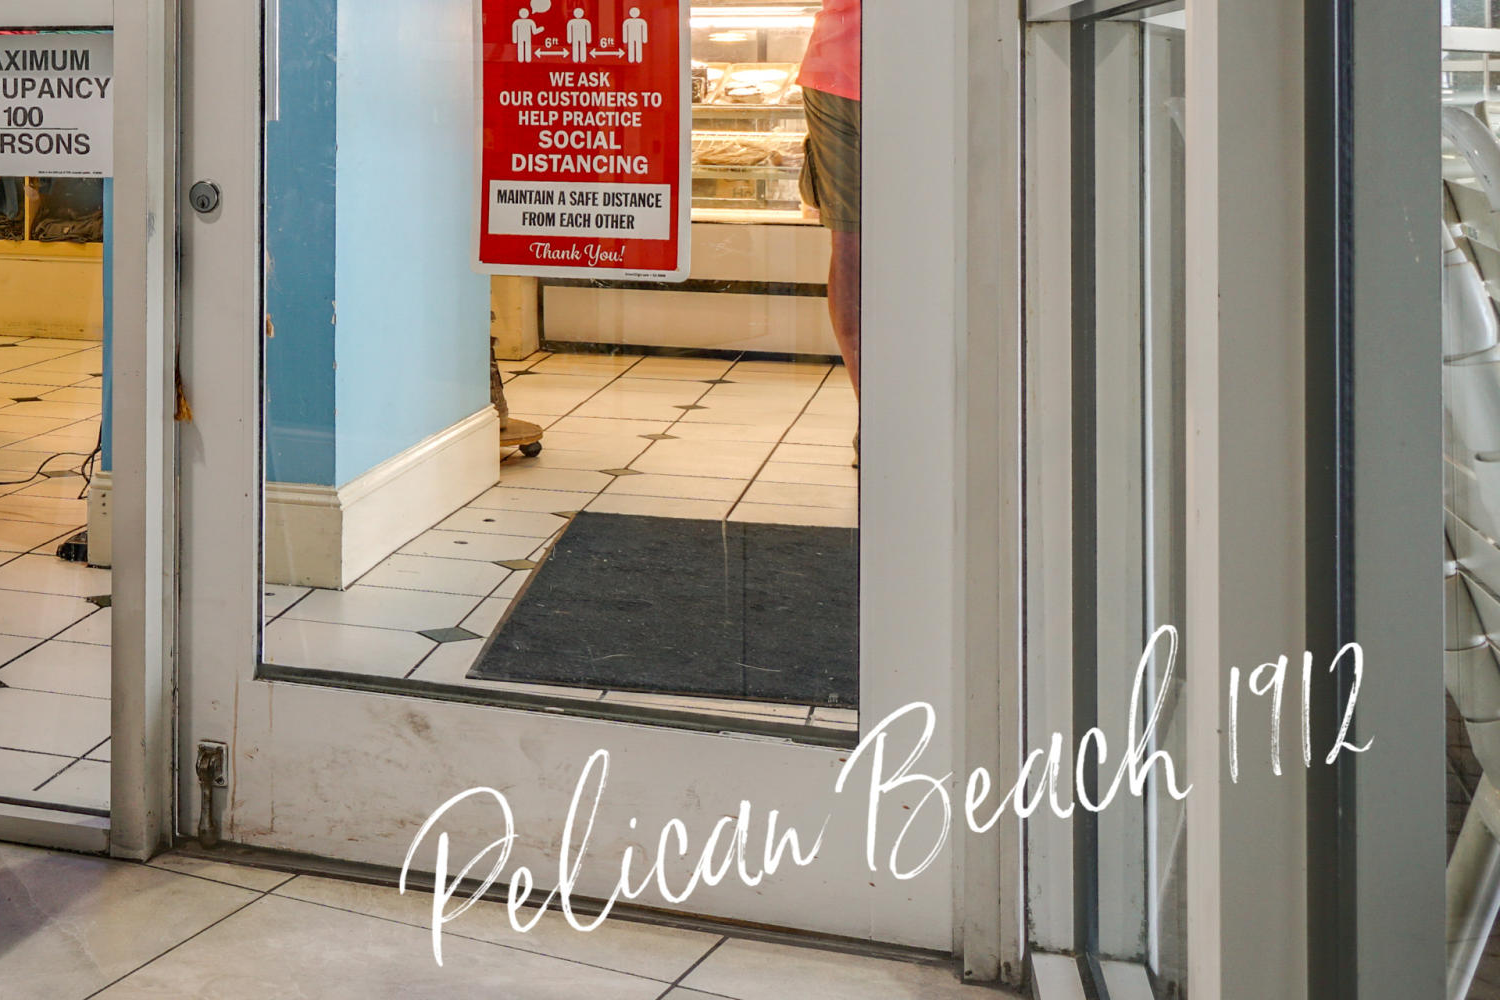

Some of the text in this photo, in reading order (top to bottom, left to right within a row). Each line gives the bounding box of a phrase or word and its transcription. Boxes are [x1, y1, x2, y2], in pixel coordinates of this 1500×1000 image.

[545, 37, 559, 48] 6ft
[600, 37, 615, 48] 6ft
[549, 72, 610, 87] WE ASK
[500, 91, 662, 108] OUR CUSTOMERS TO
[3, 106, 44, 128] 100
[518, 111, 642, 127] HELP PRACTICE
[538, 130, 622, 150] SOCIAL
[511, 153, 649, 175] DISTANCING
[497, 189, 663, 209] MAINTAIN A SAFE DISTANCE
[522, 212, 635, 230] FROM EACH OTHER
[529, 242, 625, 267] Thank You!
